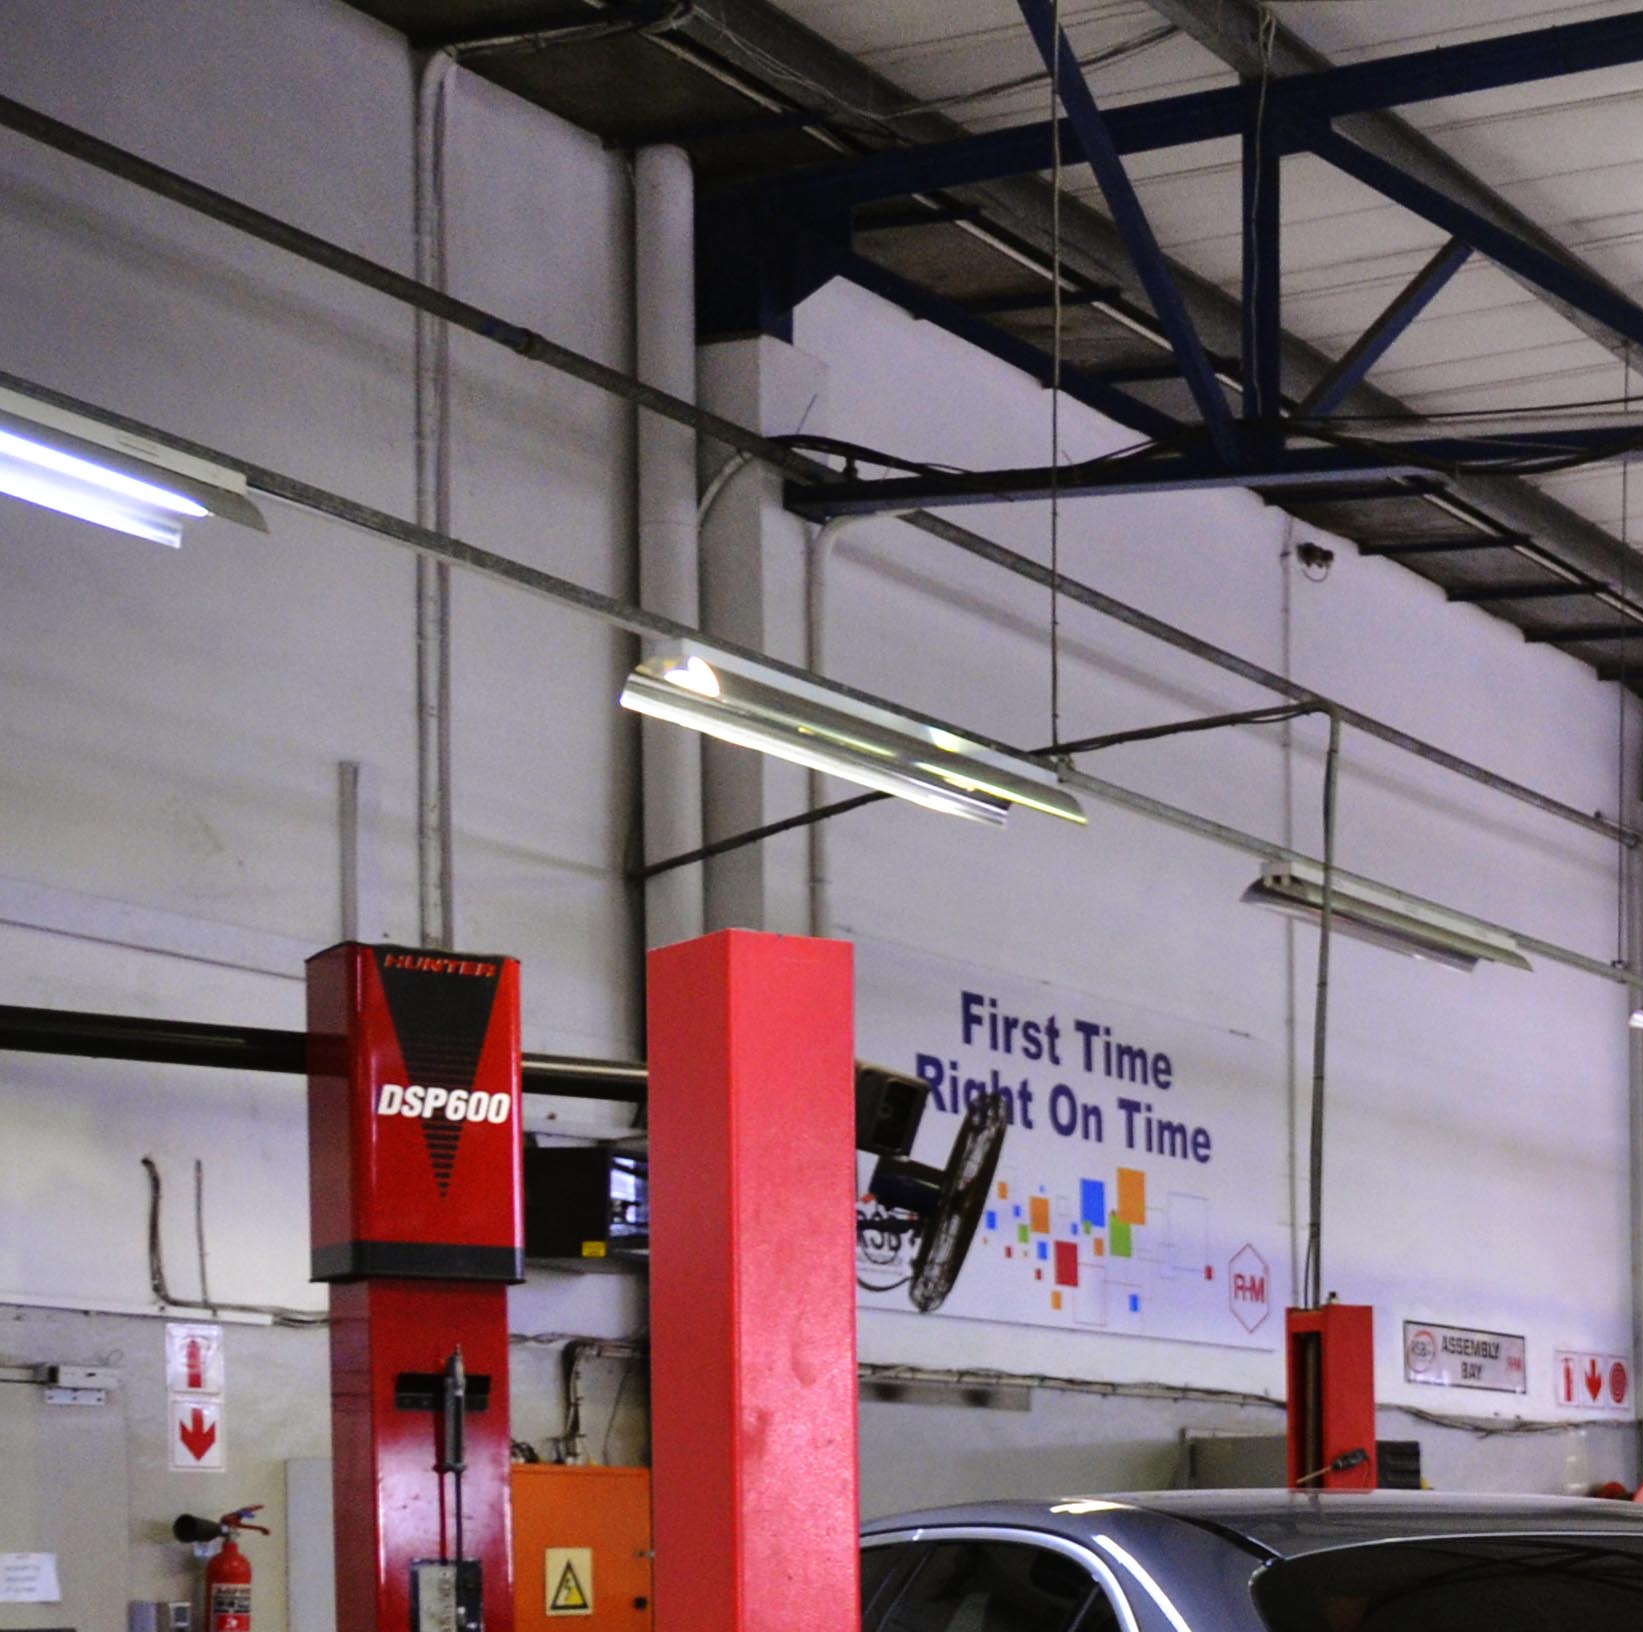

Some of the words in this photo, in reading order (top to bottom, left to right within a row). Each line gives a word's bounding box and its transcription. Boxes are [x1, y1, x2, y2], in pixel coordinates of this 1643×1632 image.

[384, 954, 497, 977] HUNTER
[961, 990, 1060, 1065] First
[1074, 1018, 1173, 1090] Time
[377, 1083, 512, 1124] DSP600
[1049, 1083, 1104, 1143] On
[1116, 1097, 1211, 1163] Time
[1441, 1336, 1500, 1360] ASSEMBLY
[1461, 1362, 1482, 1381] BAY
